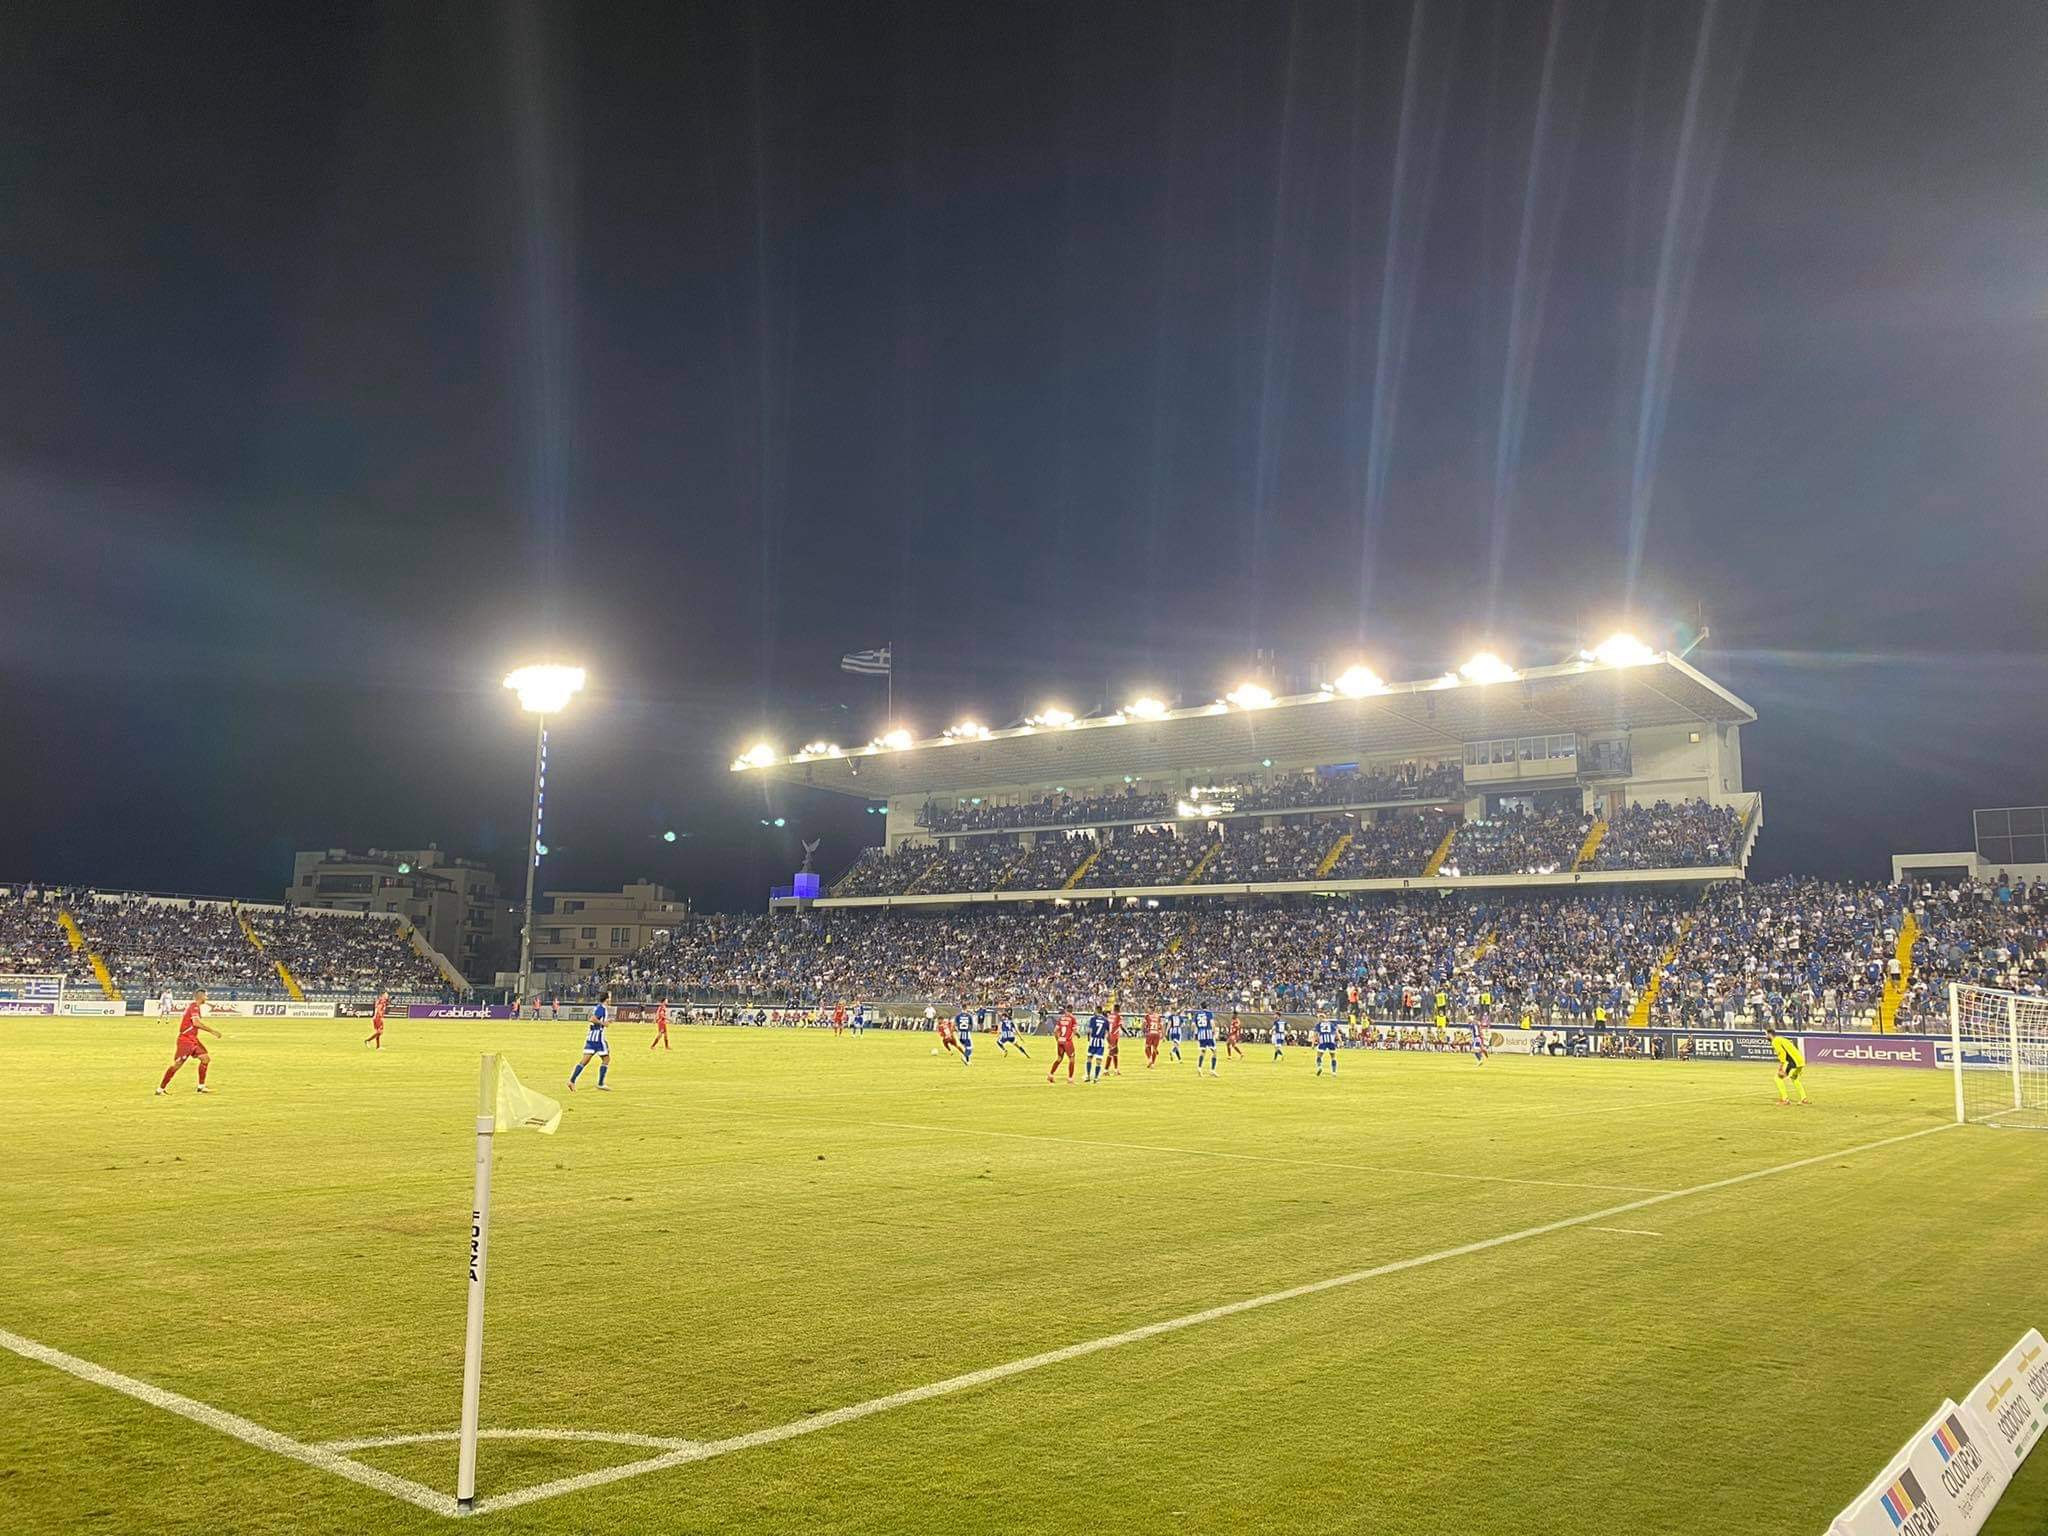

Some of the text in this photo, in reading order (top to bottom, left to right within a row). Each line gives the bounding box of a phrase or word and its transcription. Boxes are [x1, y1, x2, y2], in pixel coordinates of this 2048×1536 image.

[438, 1006, 492, 1018] cablenet
[1096, 1023, 1103, 1035] 7
[1832, 1045, 1922, 1062] cablenet
[469, 1210, 481, 1282] FORZA
